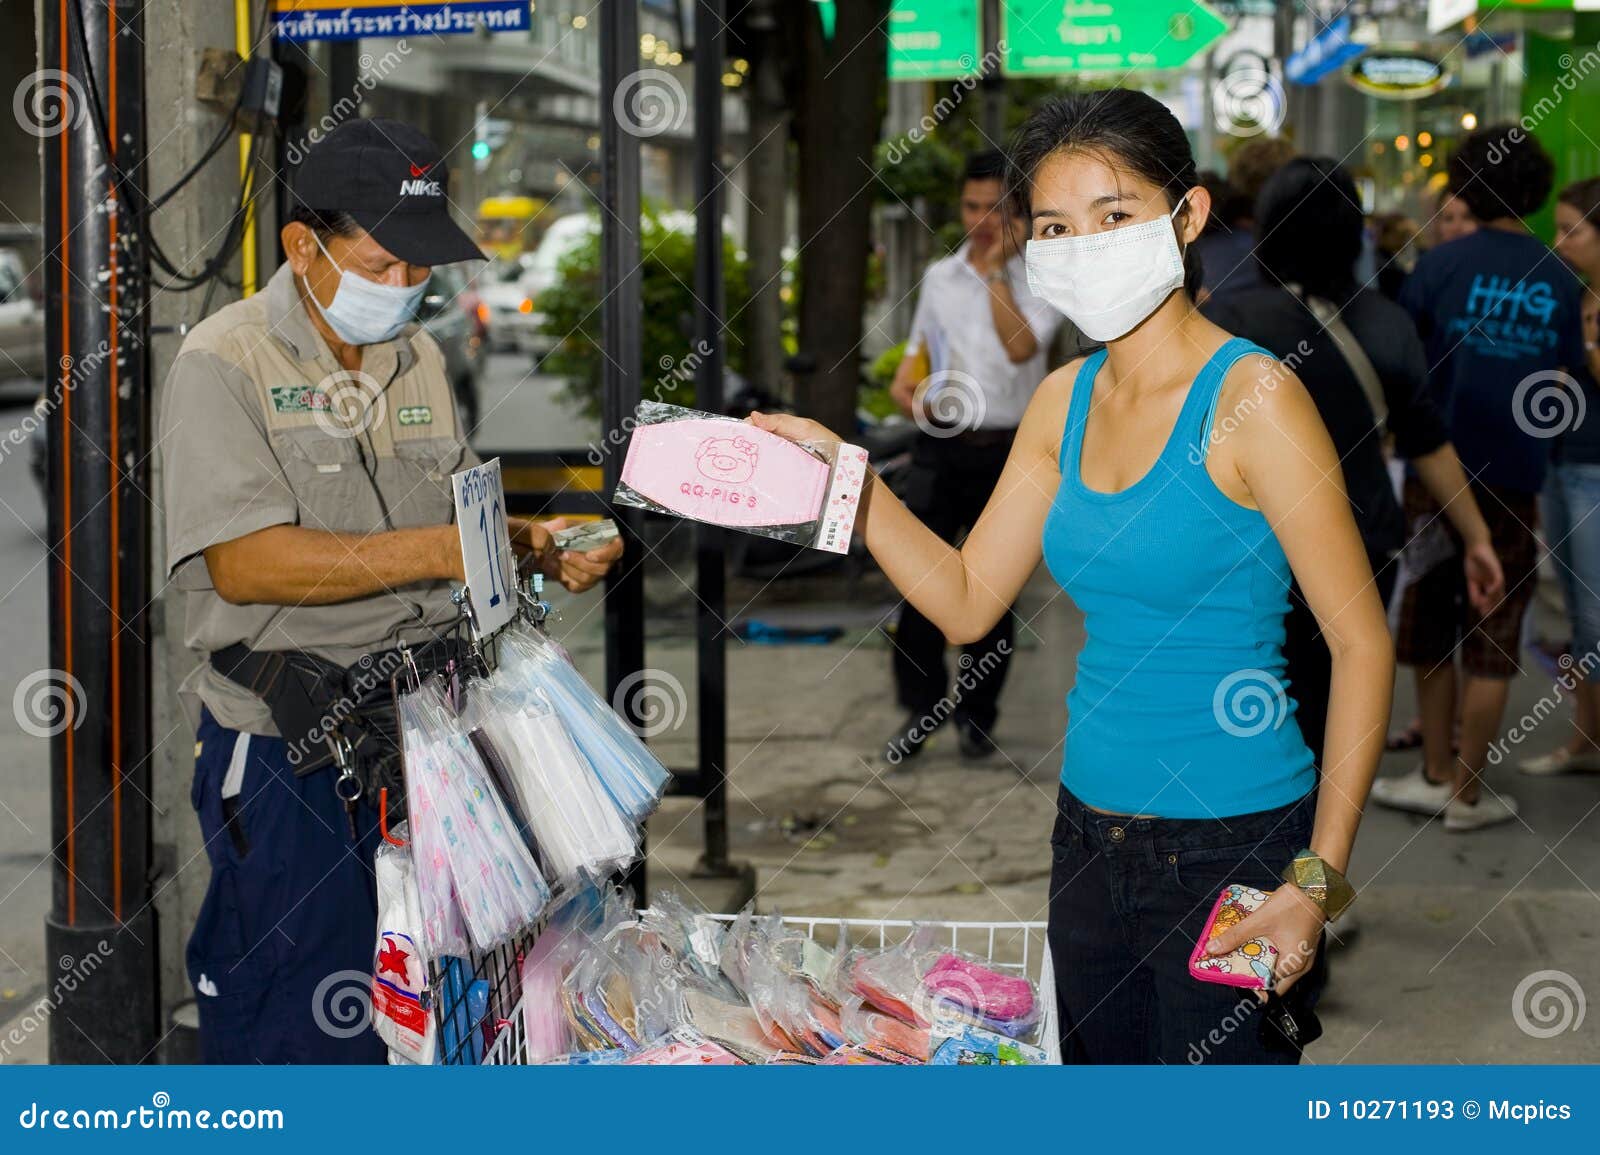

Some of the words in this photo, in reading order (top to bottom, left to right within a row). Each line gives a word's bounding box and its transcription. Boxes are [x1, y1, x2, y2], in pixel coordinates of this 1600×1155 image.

[400, 180, 441, 196] NIKE
[680, 482, 757, 508] QQ-PIG'S
[480, 498, 510, 608] 10
